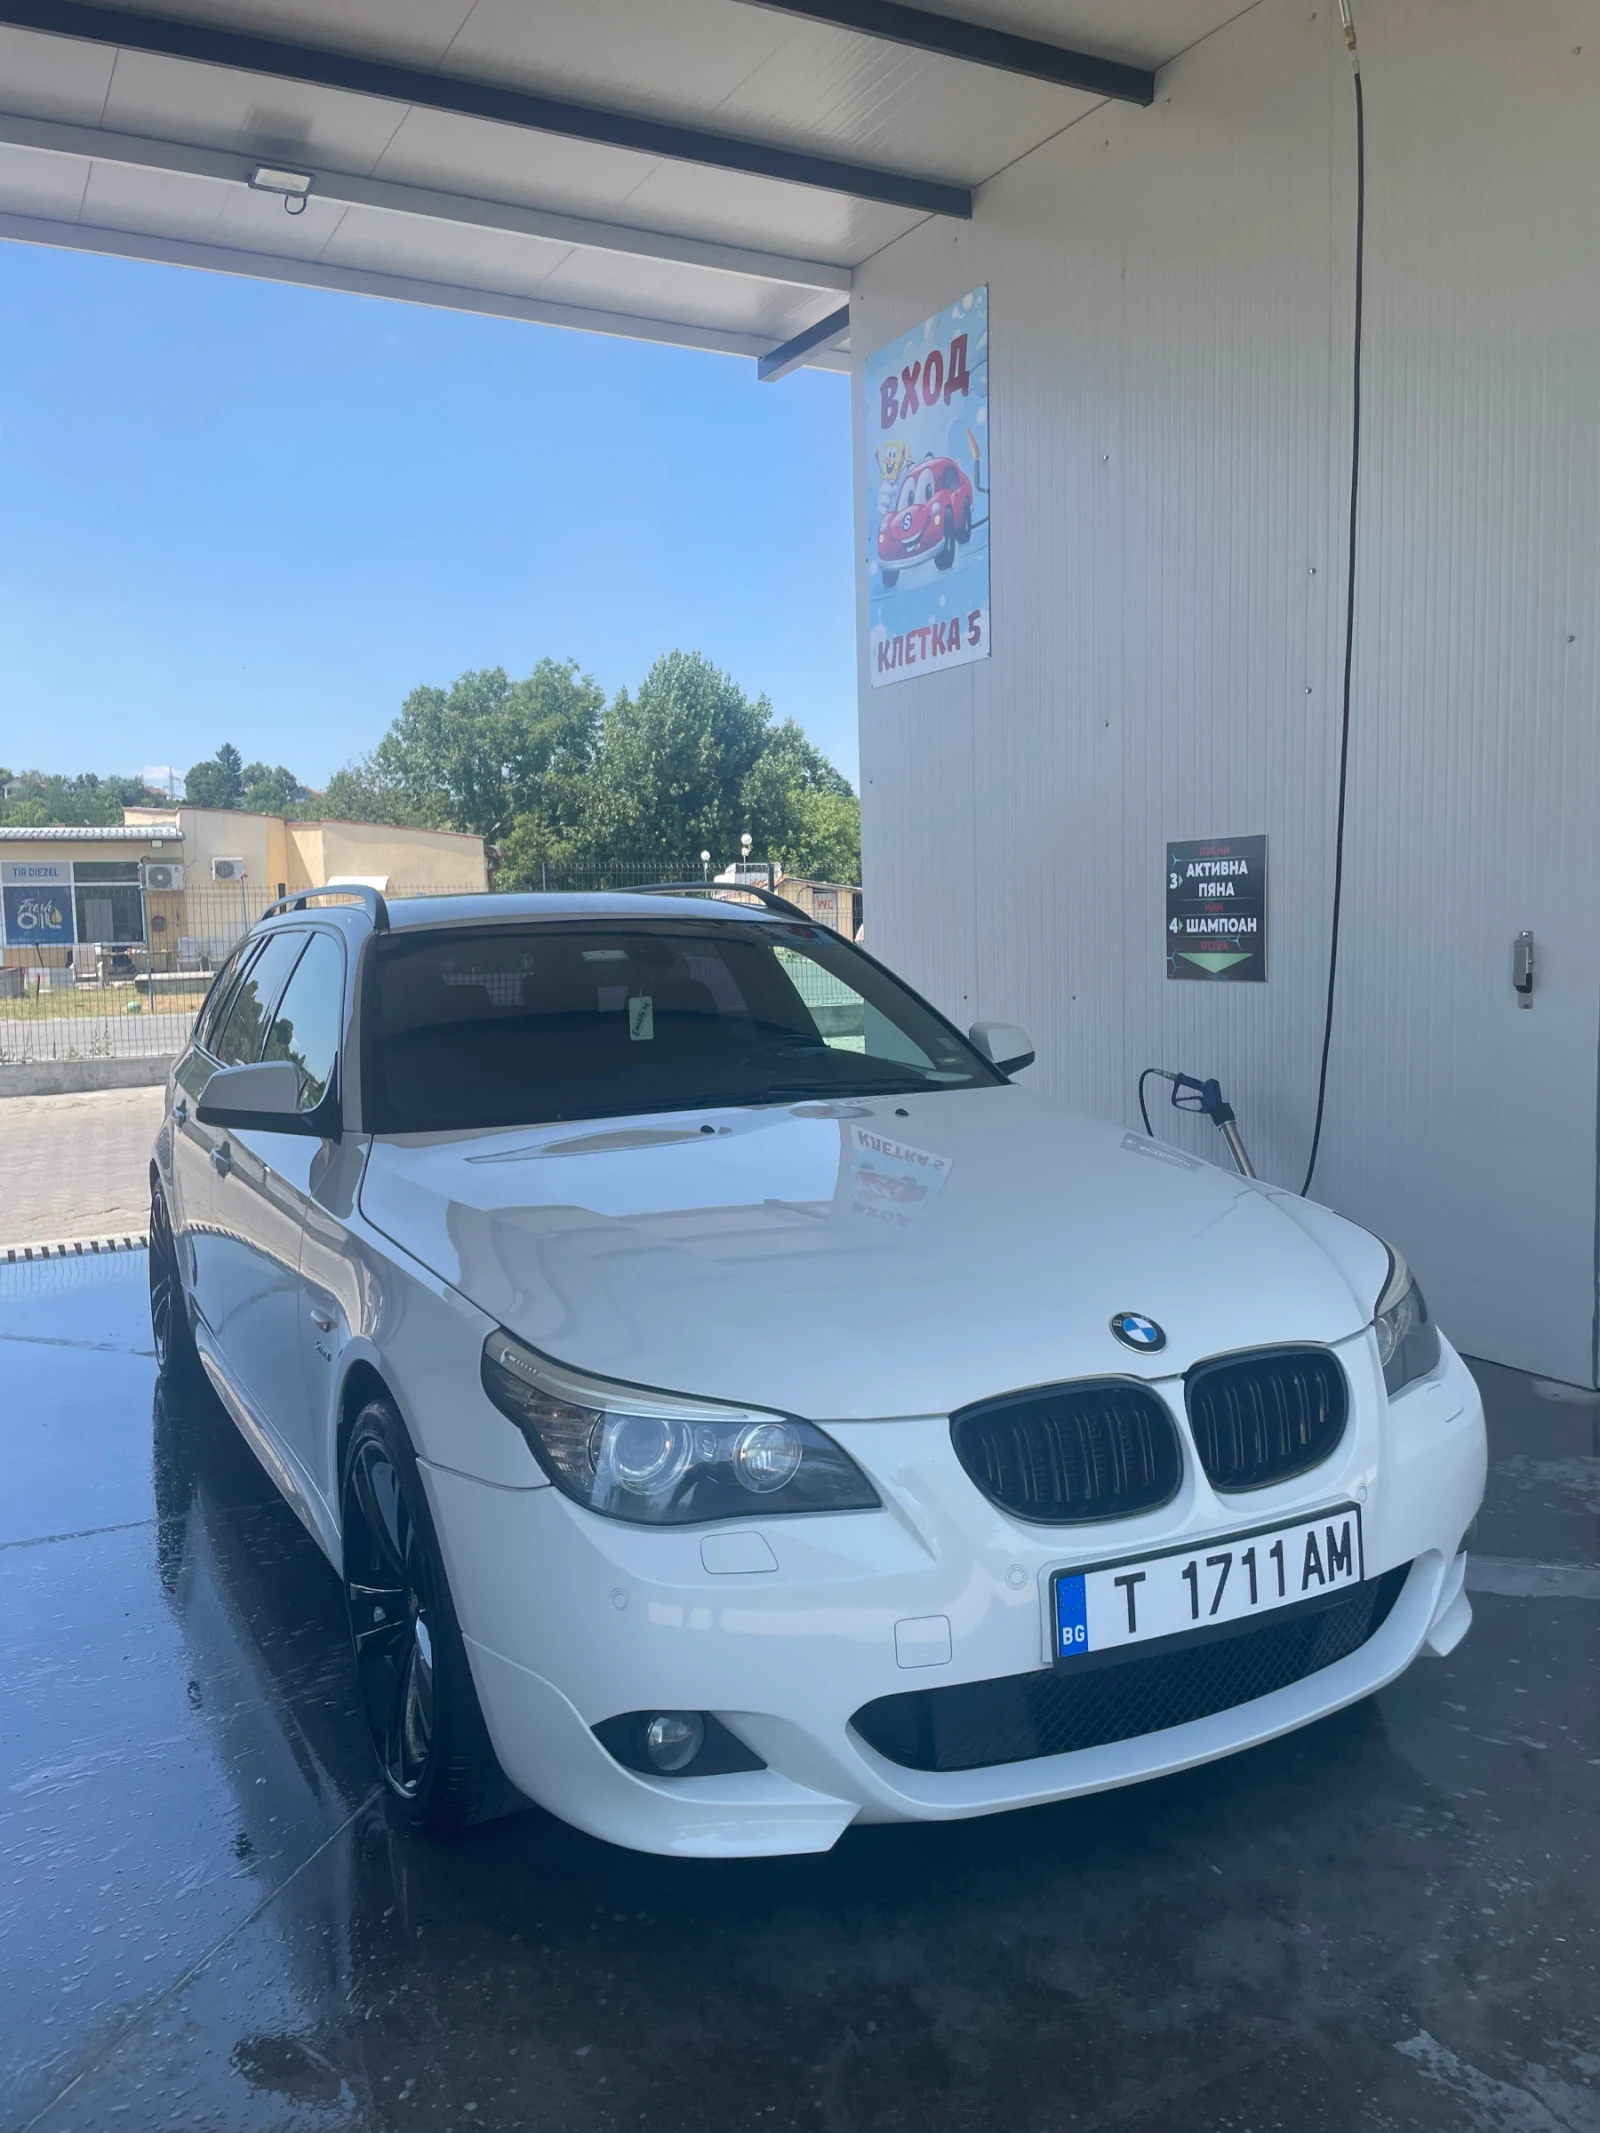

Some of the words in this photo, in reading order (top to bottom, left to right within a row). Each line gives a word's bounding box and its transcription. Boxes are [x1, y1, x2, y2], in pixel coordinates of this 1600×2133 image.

[879, 333, 970, 430] ВХОД
[877, 624, 961, 673] КЛЕТКА
[968, 610, 982, 647] 5
[13, 868, 27, 877] TIR
[29, 868, 59, 877] DIEZEL
[1186, 860, 1248, 878] АКТИВНА
[1169, 873, 1178, 889] 3
[1198, 882, 1235, 898] ПЯНА
[817, 899, 834, 910] WC
[1169, 917, 1179, 934] 4
[1186, 918, 1256, 933] ШАМПОАН
[1062, 1624, 1085, 1646] BG
